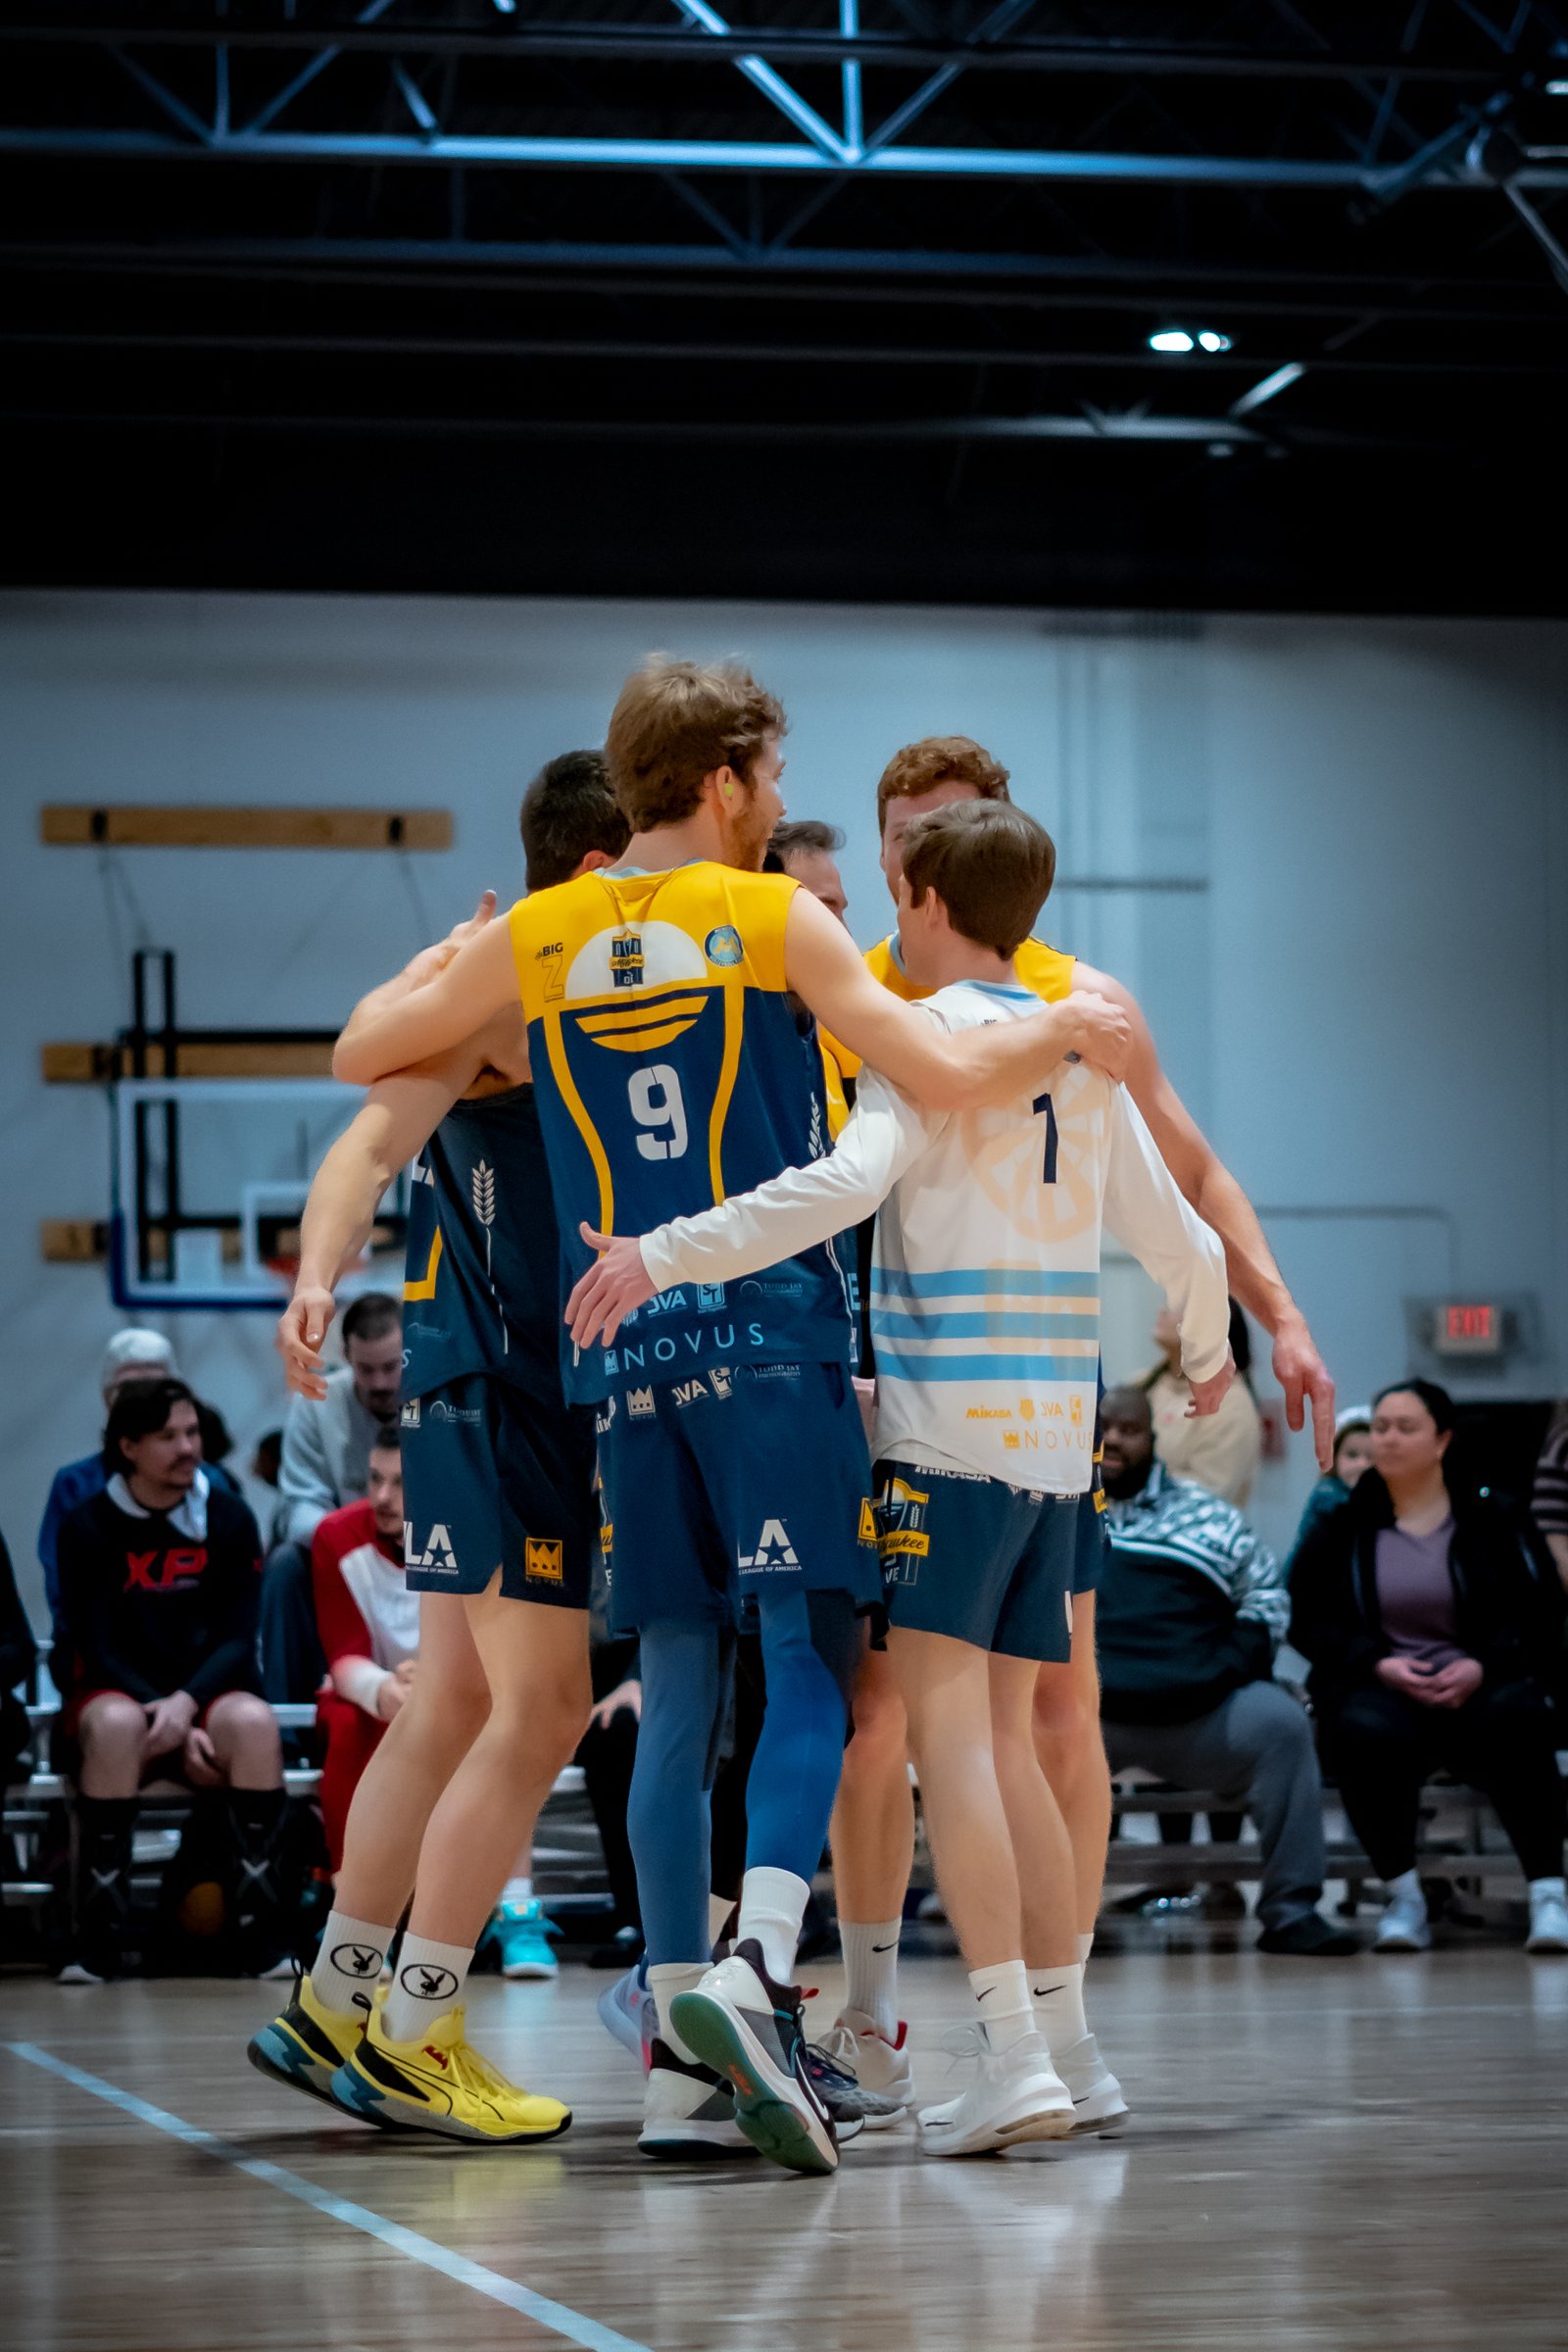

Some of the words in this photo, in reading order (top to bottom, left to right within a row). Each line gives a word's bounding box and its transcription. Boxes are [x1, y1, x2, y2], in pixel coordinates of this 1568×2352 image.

[542, 942, 564, 957] BIG
[627, 1063, 688, 1161] 9
[1032, 1093, 1057, 1184] 1
[647, 1290, 688, 1314] JVA
[623, 1322, 764, 1371] NOVUS
[672, 1379, 708, 1406] JVA
[1041, 1401, 1063, 1417] JVA
[404, 1521, 458, 1568] LA
[125, 1548, 209, 1591] XP
